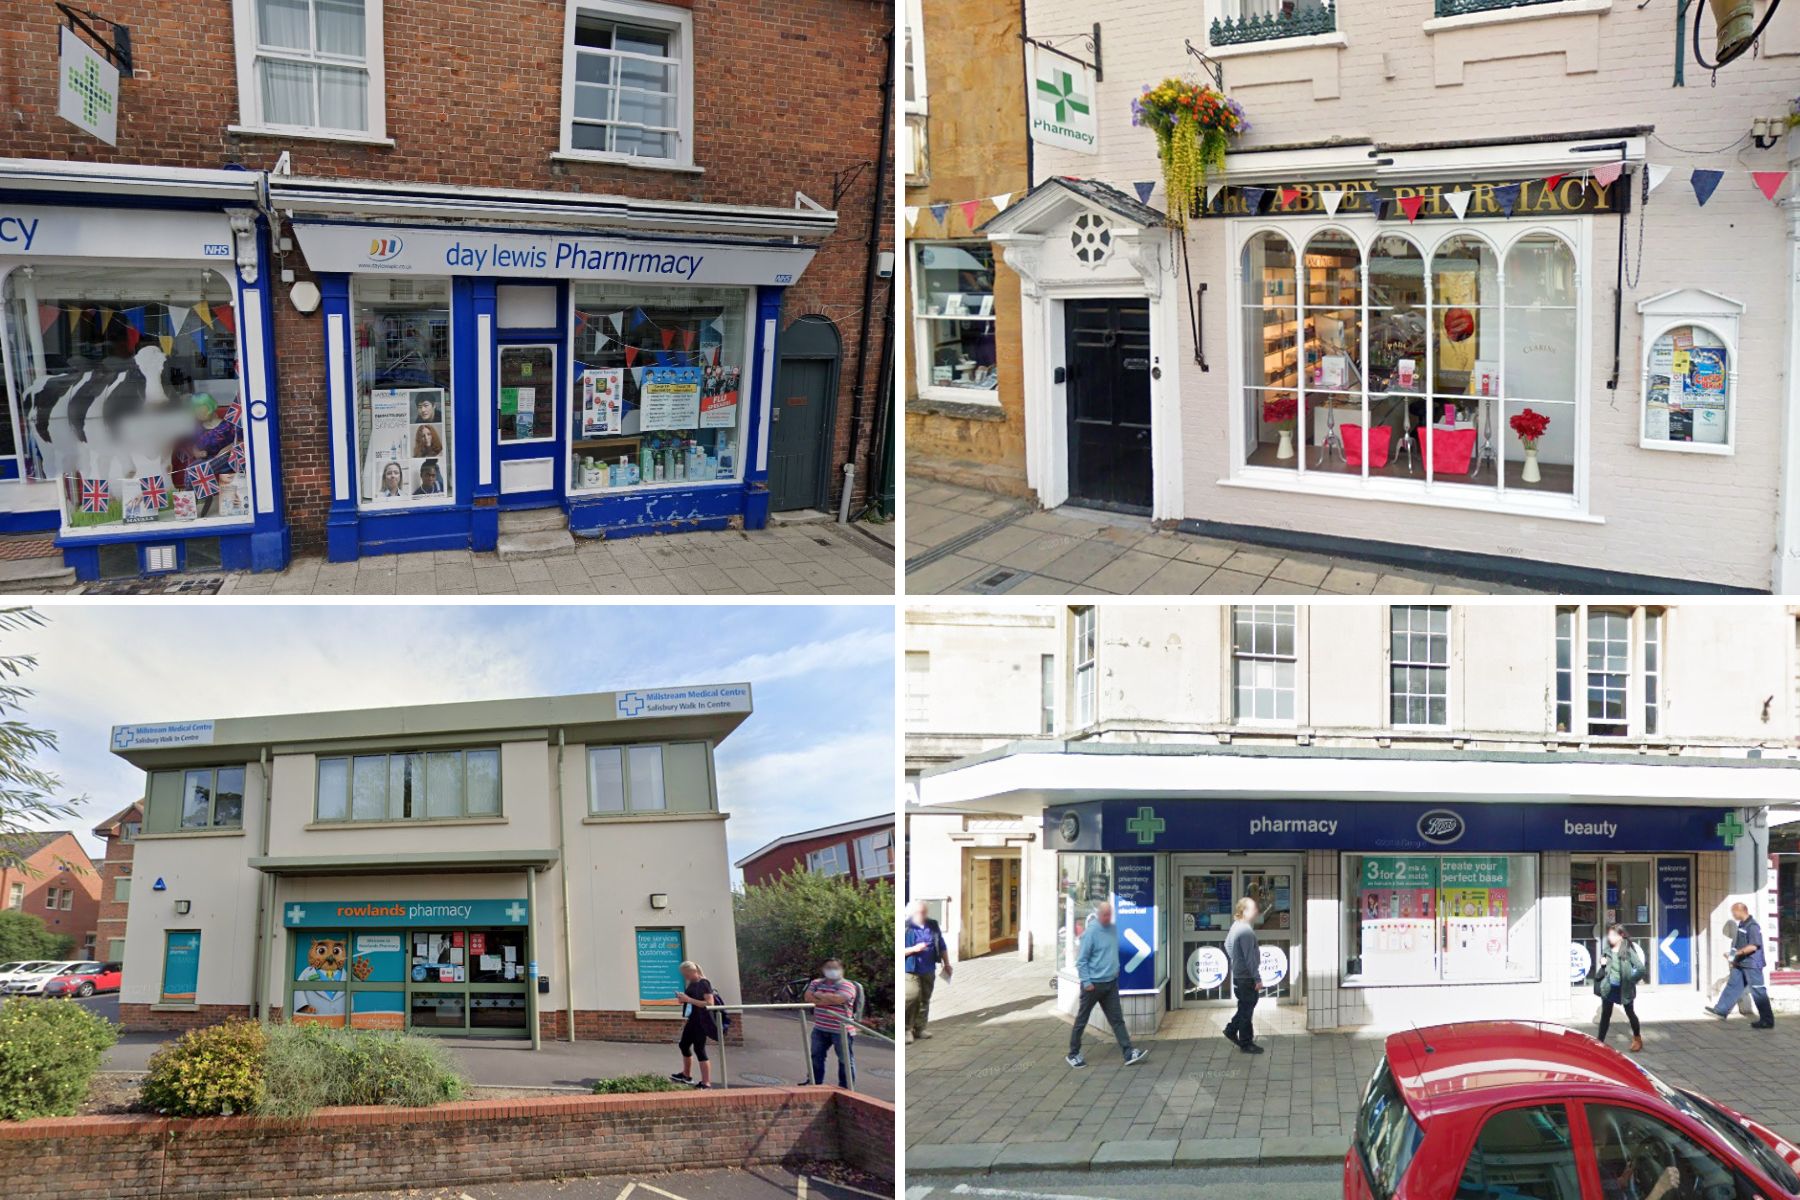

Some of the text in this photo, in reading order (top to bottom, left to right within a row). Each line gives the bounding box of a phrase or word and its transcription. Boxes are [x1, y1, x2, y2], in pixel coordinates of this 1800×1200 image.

[1033, 118, 1095, 145] Pharmacy
[205, 245, 228, 255] NHS
[446, 242, 488, 271] day
[493, 244, 547, 268] lewis
[775, 275, 792, 283] NHS
[647, 688, 746, 701] Millstream Medical Centre
[647, 703, 678, 712] Salisbury
[679, 702, 697, 710] Walk
[707, 700, 731, 708] Centre
[136, 723, 213, 735] Millstream Medical Centre
[135, 736, 159, 745] Salisbury
[160, 735, 173, 743] Walk
[180, 734, 199, 742] Centre
[1250, 817, 1338, 836] pharmacy
[1564, 819, 1618, 838] beauty
[1367, 861, 1406, 880] 3 for 2
[1442, 862, 1497, 873] create your
[1659, 864, 1687, 872] welcome
[1442, 872, 1503, 883] perfect base
[336, 903, 472, 920] rowlands pharmacy
